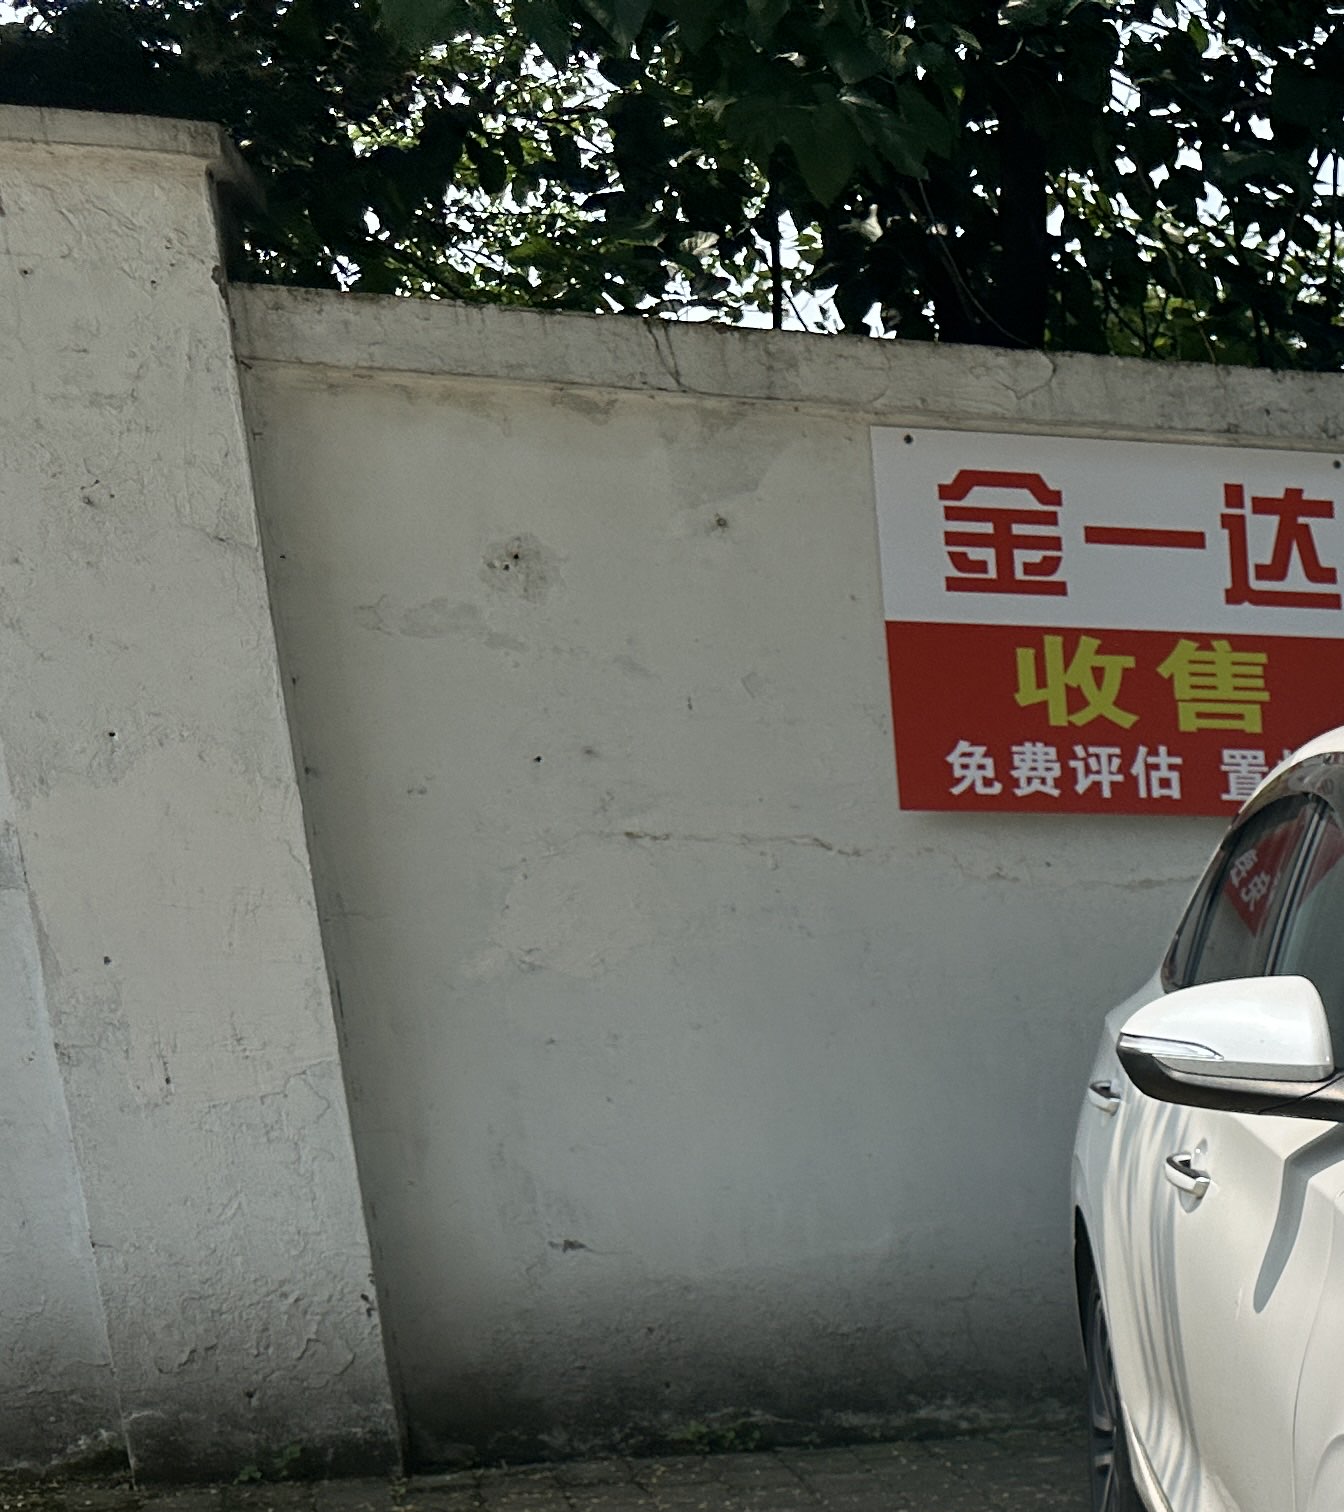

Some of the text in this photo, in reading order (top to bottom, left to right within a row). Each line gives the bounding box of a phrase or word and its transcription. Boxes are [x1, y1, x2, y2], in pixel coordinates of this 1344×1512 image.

[1014, 635, 1271, 733] 收售
[946, 739, 1290, 801] 免费评估 置
